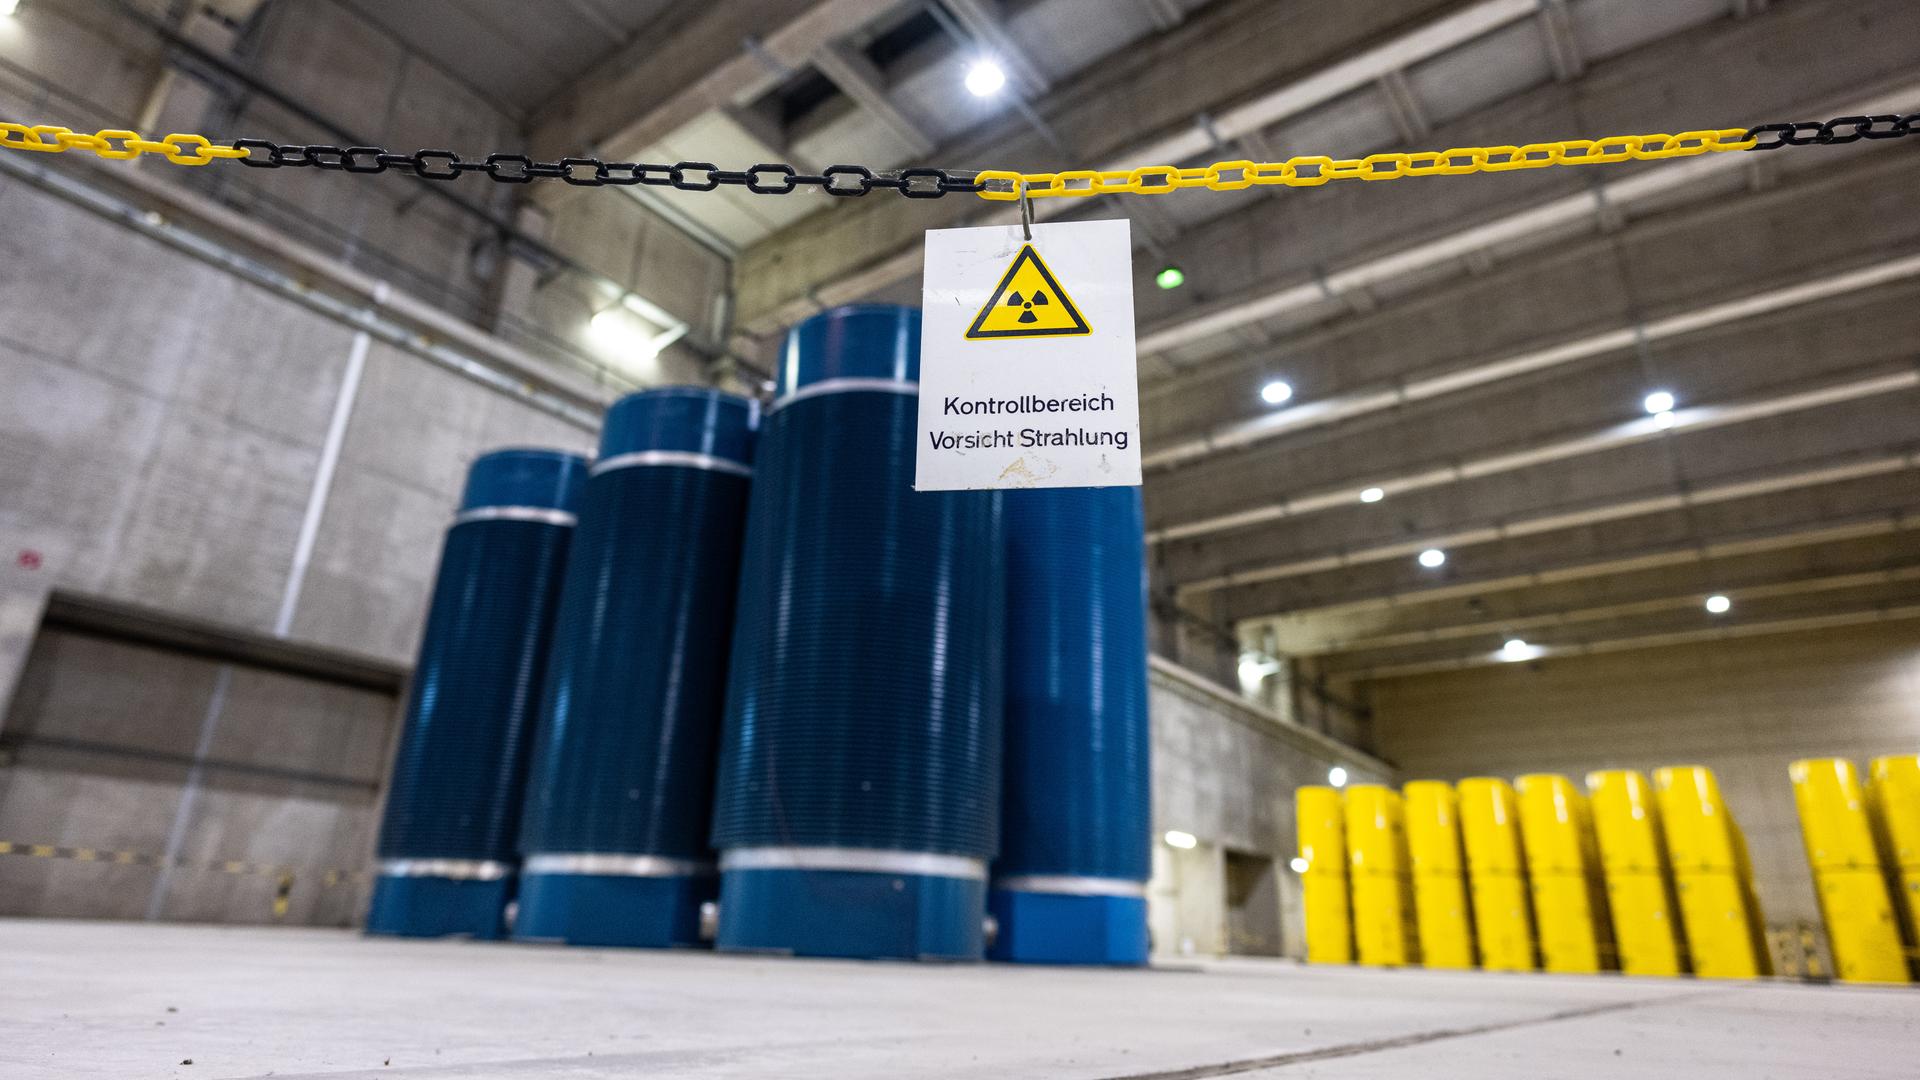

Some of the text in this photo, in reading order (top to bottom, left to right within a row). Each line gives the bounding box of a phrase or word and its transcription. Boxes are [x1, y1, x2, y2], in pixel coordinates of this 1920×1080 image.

[943, 393, 1114, 415] Kontrollbereich
[930, 428, 1128, 450] Vorsicht Strahlung
